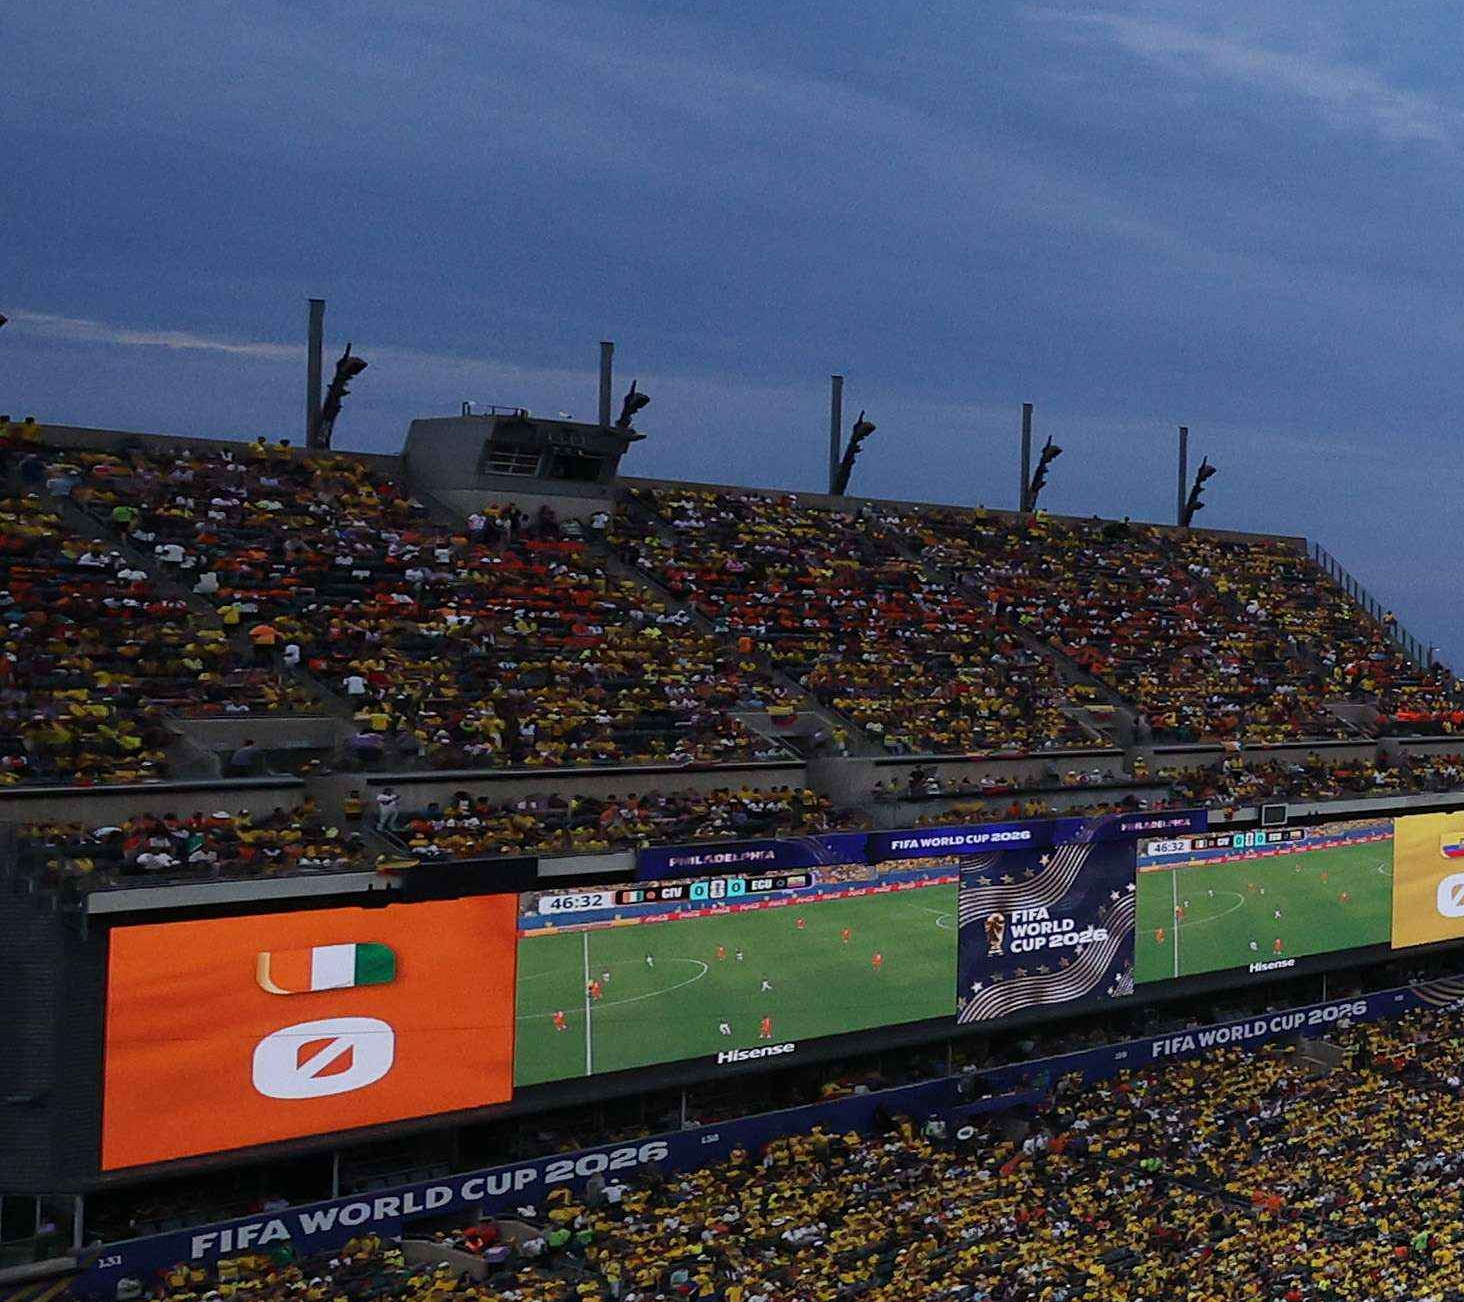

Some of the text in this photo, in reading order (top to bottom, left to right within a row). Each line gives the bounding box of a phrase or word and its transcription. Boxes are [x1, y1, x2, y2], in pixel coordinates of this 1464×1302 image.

[891, 830, 1031, 850] FIFA WORLD CUP 2026
[1154, 842, 1185, 853] 46:32
[669, 849, 776, 867] PHILADELPHIA
[550, 895, 603, 911] 46:32
[1011, 907, 1050, 924] FIFA
[1010, 919, 1075, 938] WORLD
[1010, 928, 1109, 954] CUP 2026
[1250, 959, 1295, 974] Hisense
[1152, 1033, 1196, 1059] FIFA
[1198, 1020, 1267, 1047] WORLD
[1270, 1012, 1305, 1033] CUP
[1308, 1001, 1368, 1025] 2026
[716, 1040, 796, 1066] Hisense
[191, 1141, 670, 1261] FIFA WORLD CUP 2026
